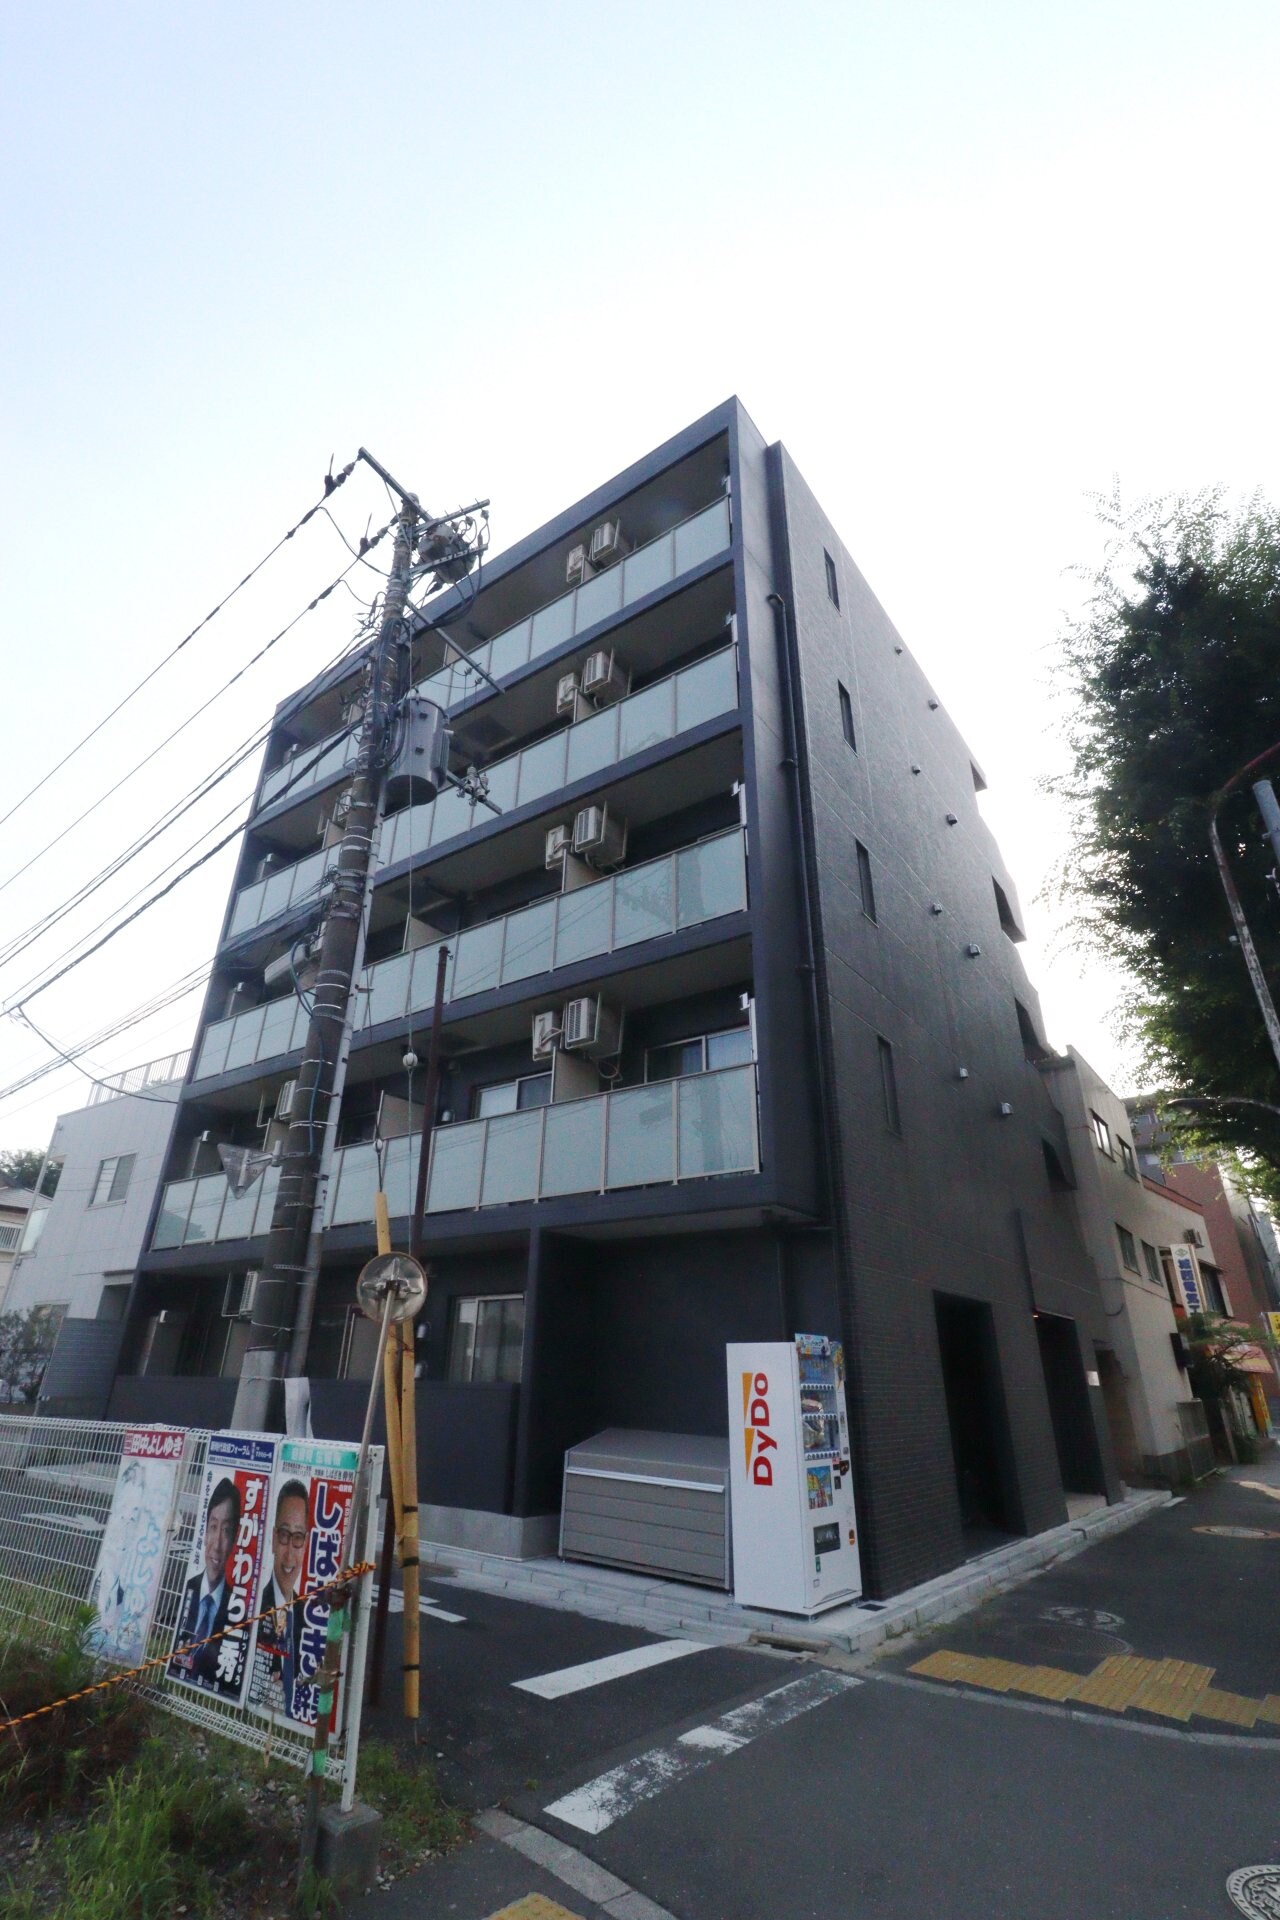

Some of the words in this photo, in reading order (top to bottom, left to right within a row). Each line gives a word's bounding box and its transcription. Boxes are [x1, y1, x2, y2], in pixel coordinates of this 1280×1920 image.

[130, 1432, 183, 1457] 田中よしゆき
[751, 1372, 778, 1486] DyDo
[215, 1477, 263, 1683] すがわら一秀
